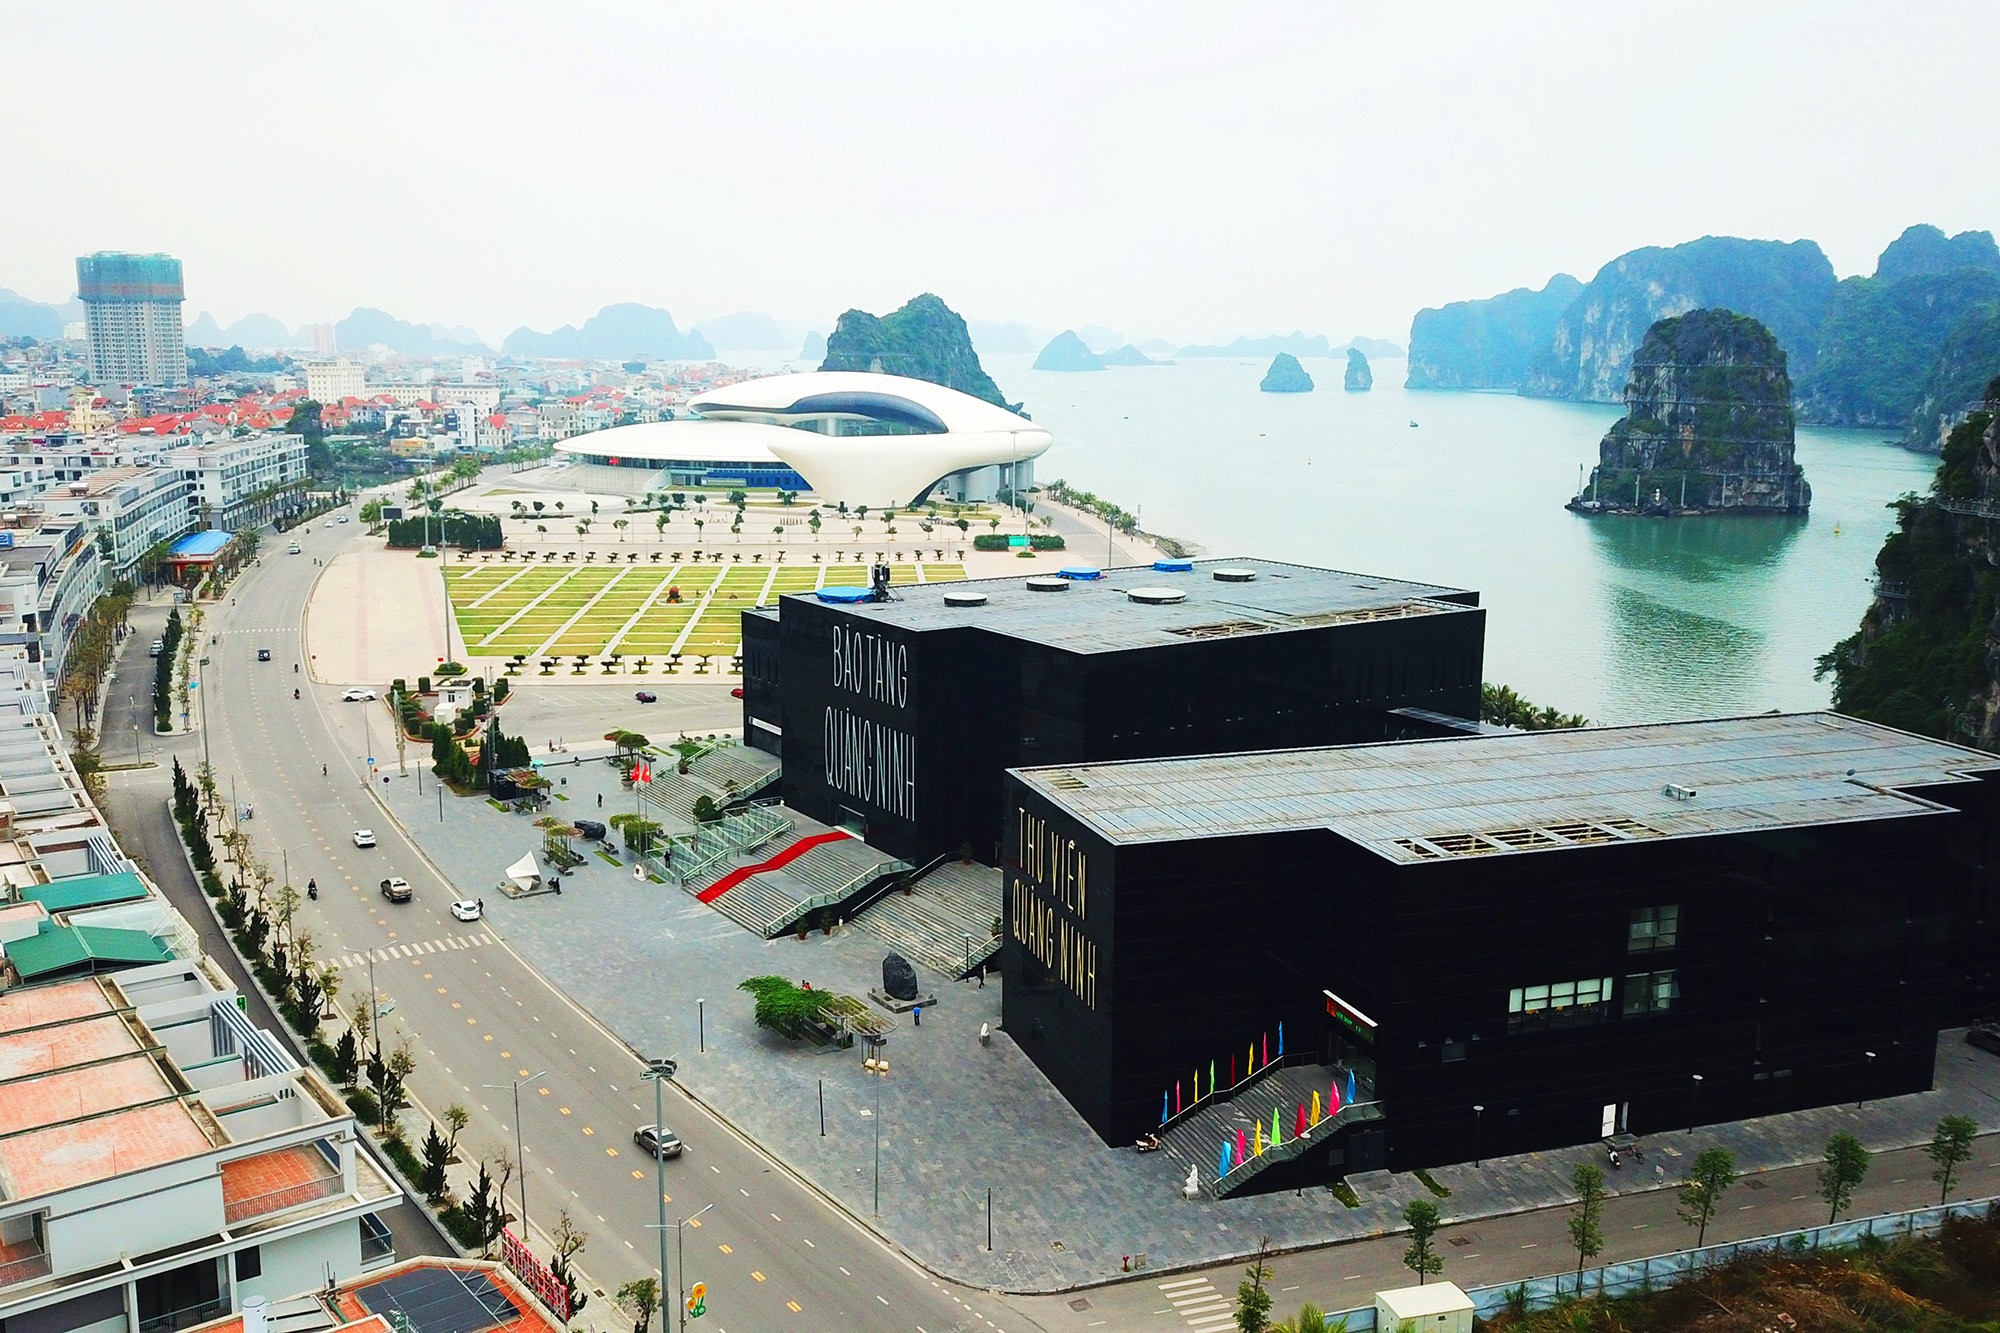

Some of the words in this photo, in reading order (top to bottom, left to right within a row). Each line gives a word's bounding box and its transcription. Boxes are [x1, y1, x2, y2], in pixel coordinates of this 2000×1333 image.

[833, 623, 863, 694] BẢO
[866, 633, 908, 709] TÀNG
[824, 705, 872, 802] QUẢNG
[876, 723, 915, 822] NINH
[1018, 807, 1046, 884] THƯ
[1051, 831, 1087, 921] VIỆN
[1012, 878, 1055, 970] QUẢNG
[1060, 917, 1097, 1012] NINH
